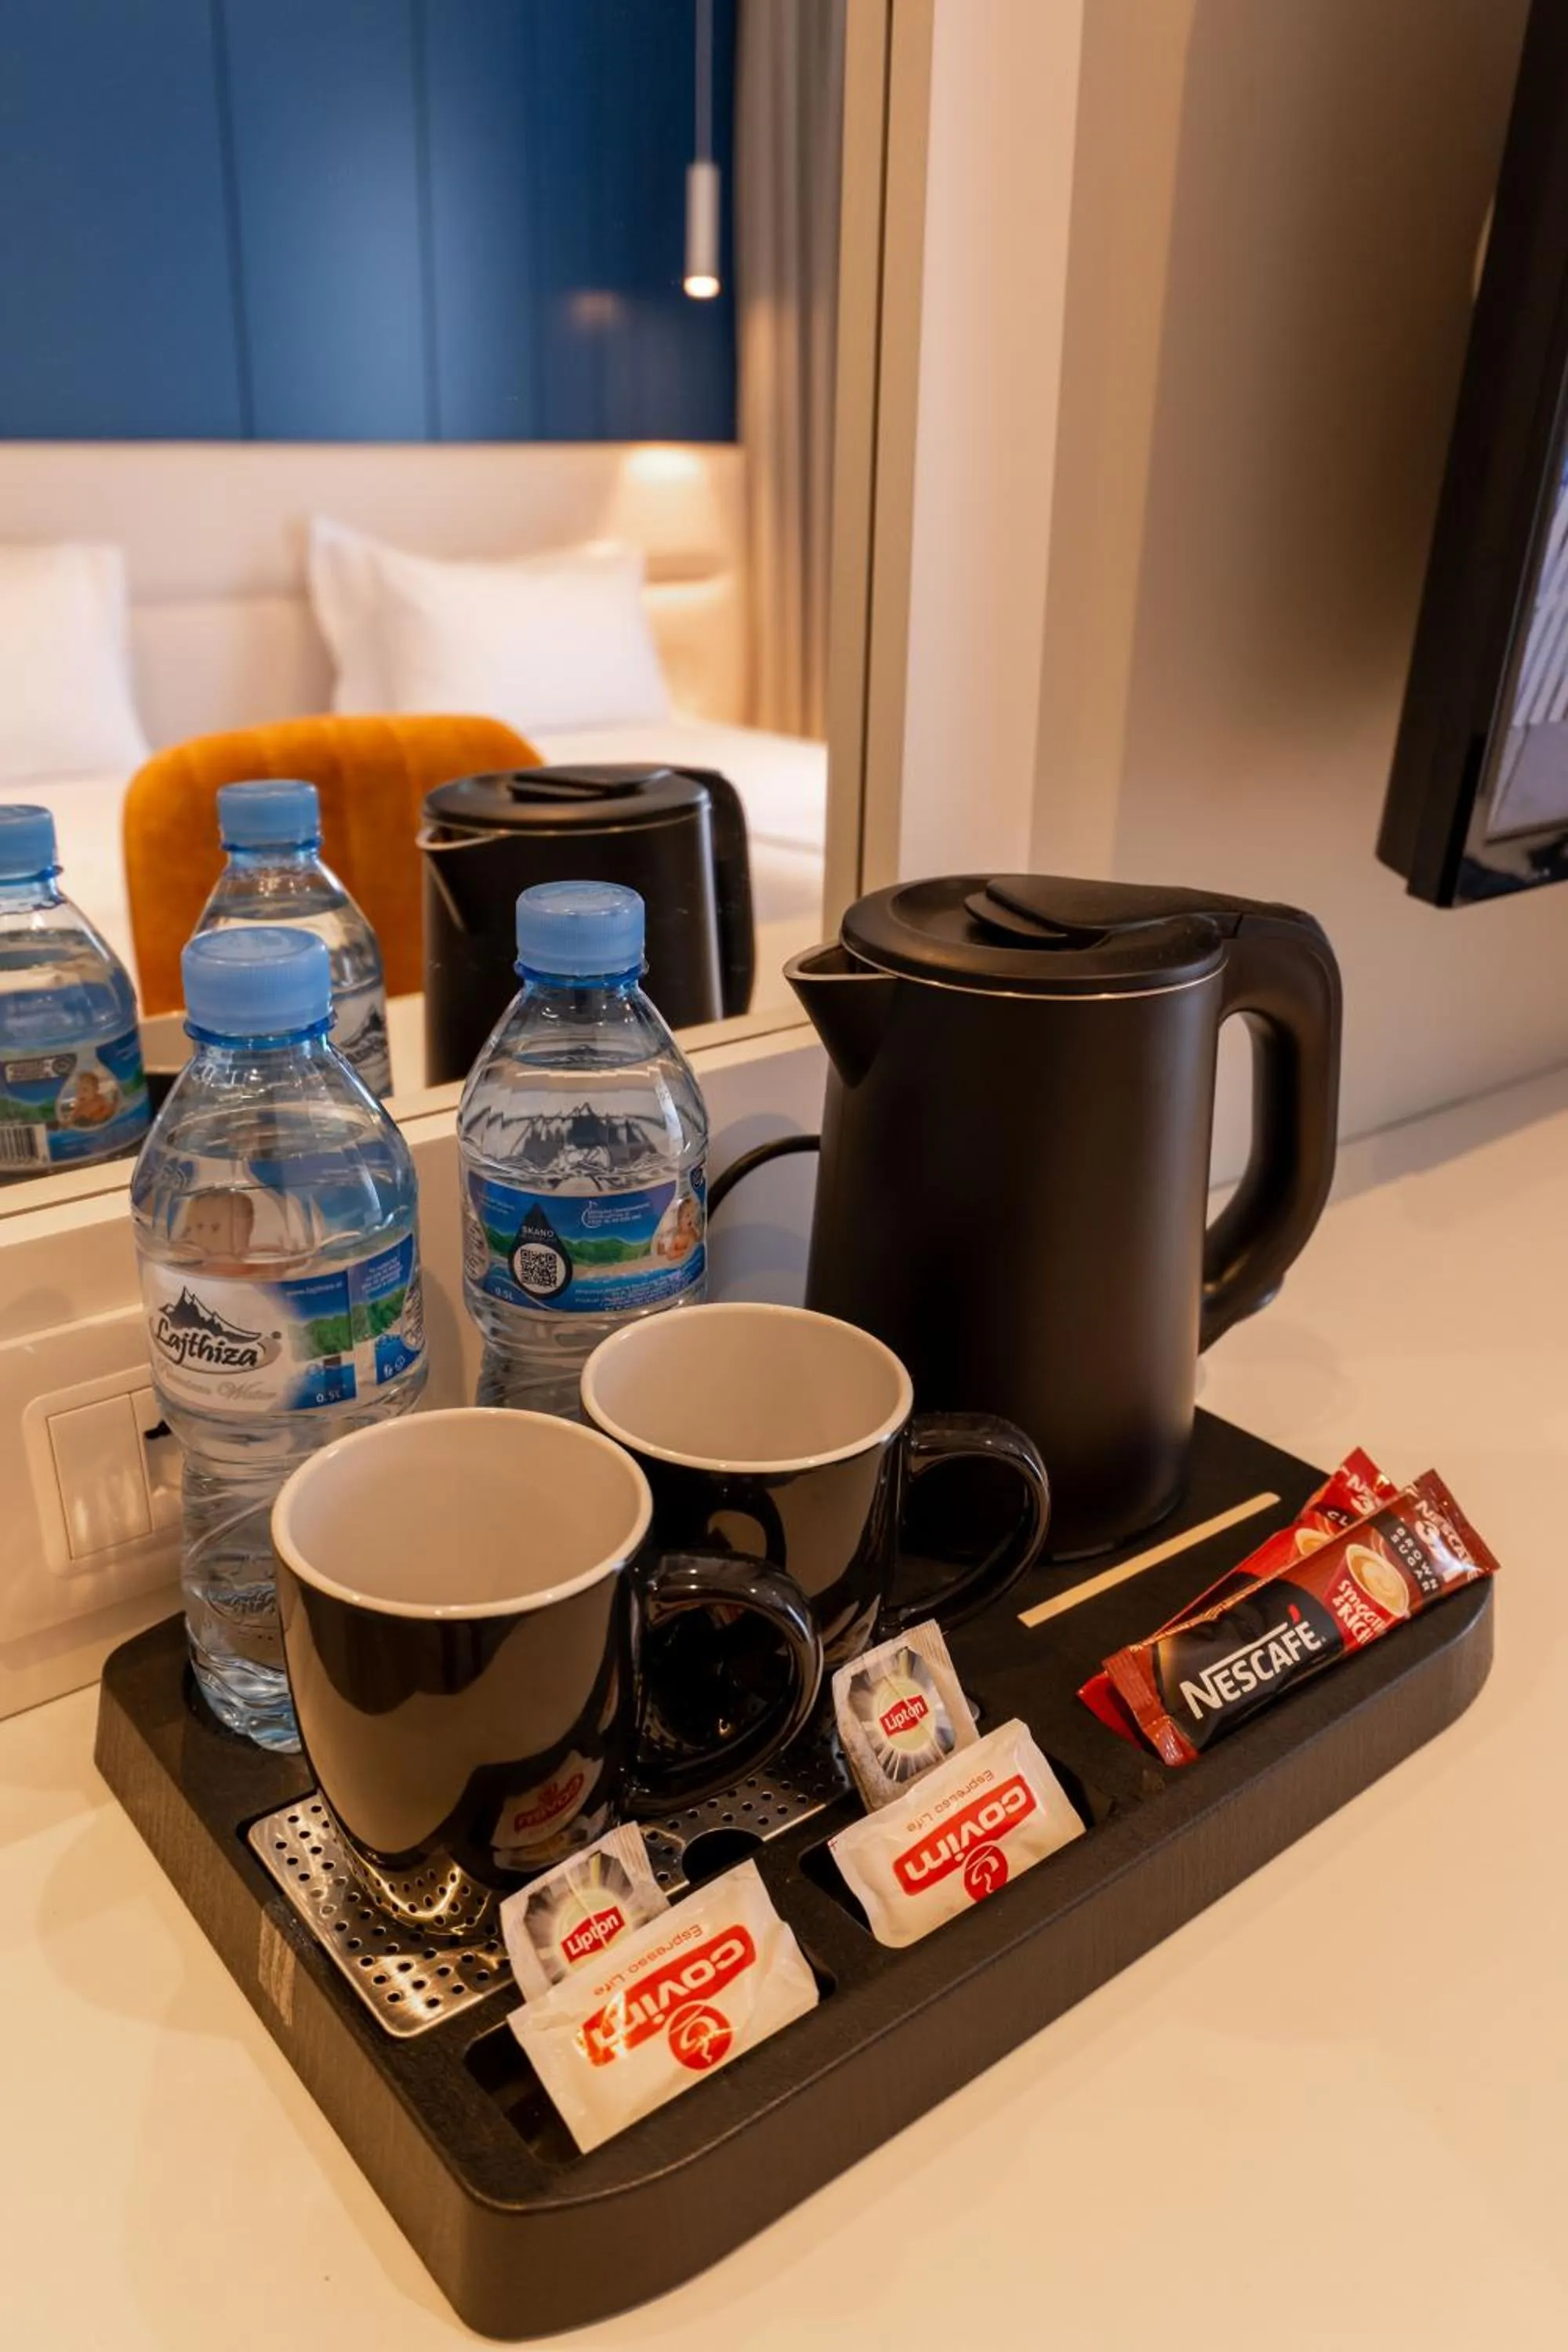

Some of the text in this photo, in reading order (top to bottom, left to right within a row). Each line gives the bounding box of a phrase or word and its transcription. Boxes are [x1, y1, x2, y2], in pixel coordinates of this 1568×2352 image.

[156, 1317, 258, 1367] Lajthiza
[1390, 1534, 1430, 1592] SUGAR
[1396, 1526, 1439, 1590] BROWN
[884, 1701, 924, 1731] Lipton
[907, 1769, 995, 1833] Espresso Life
[567, 1911, 619, 1956] Lipton
[593, 1923, 703, 1996] Espresso Life
